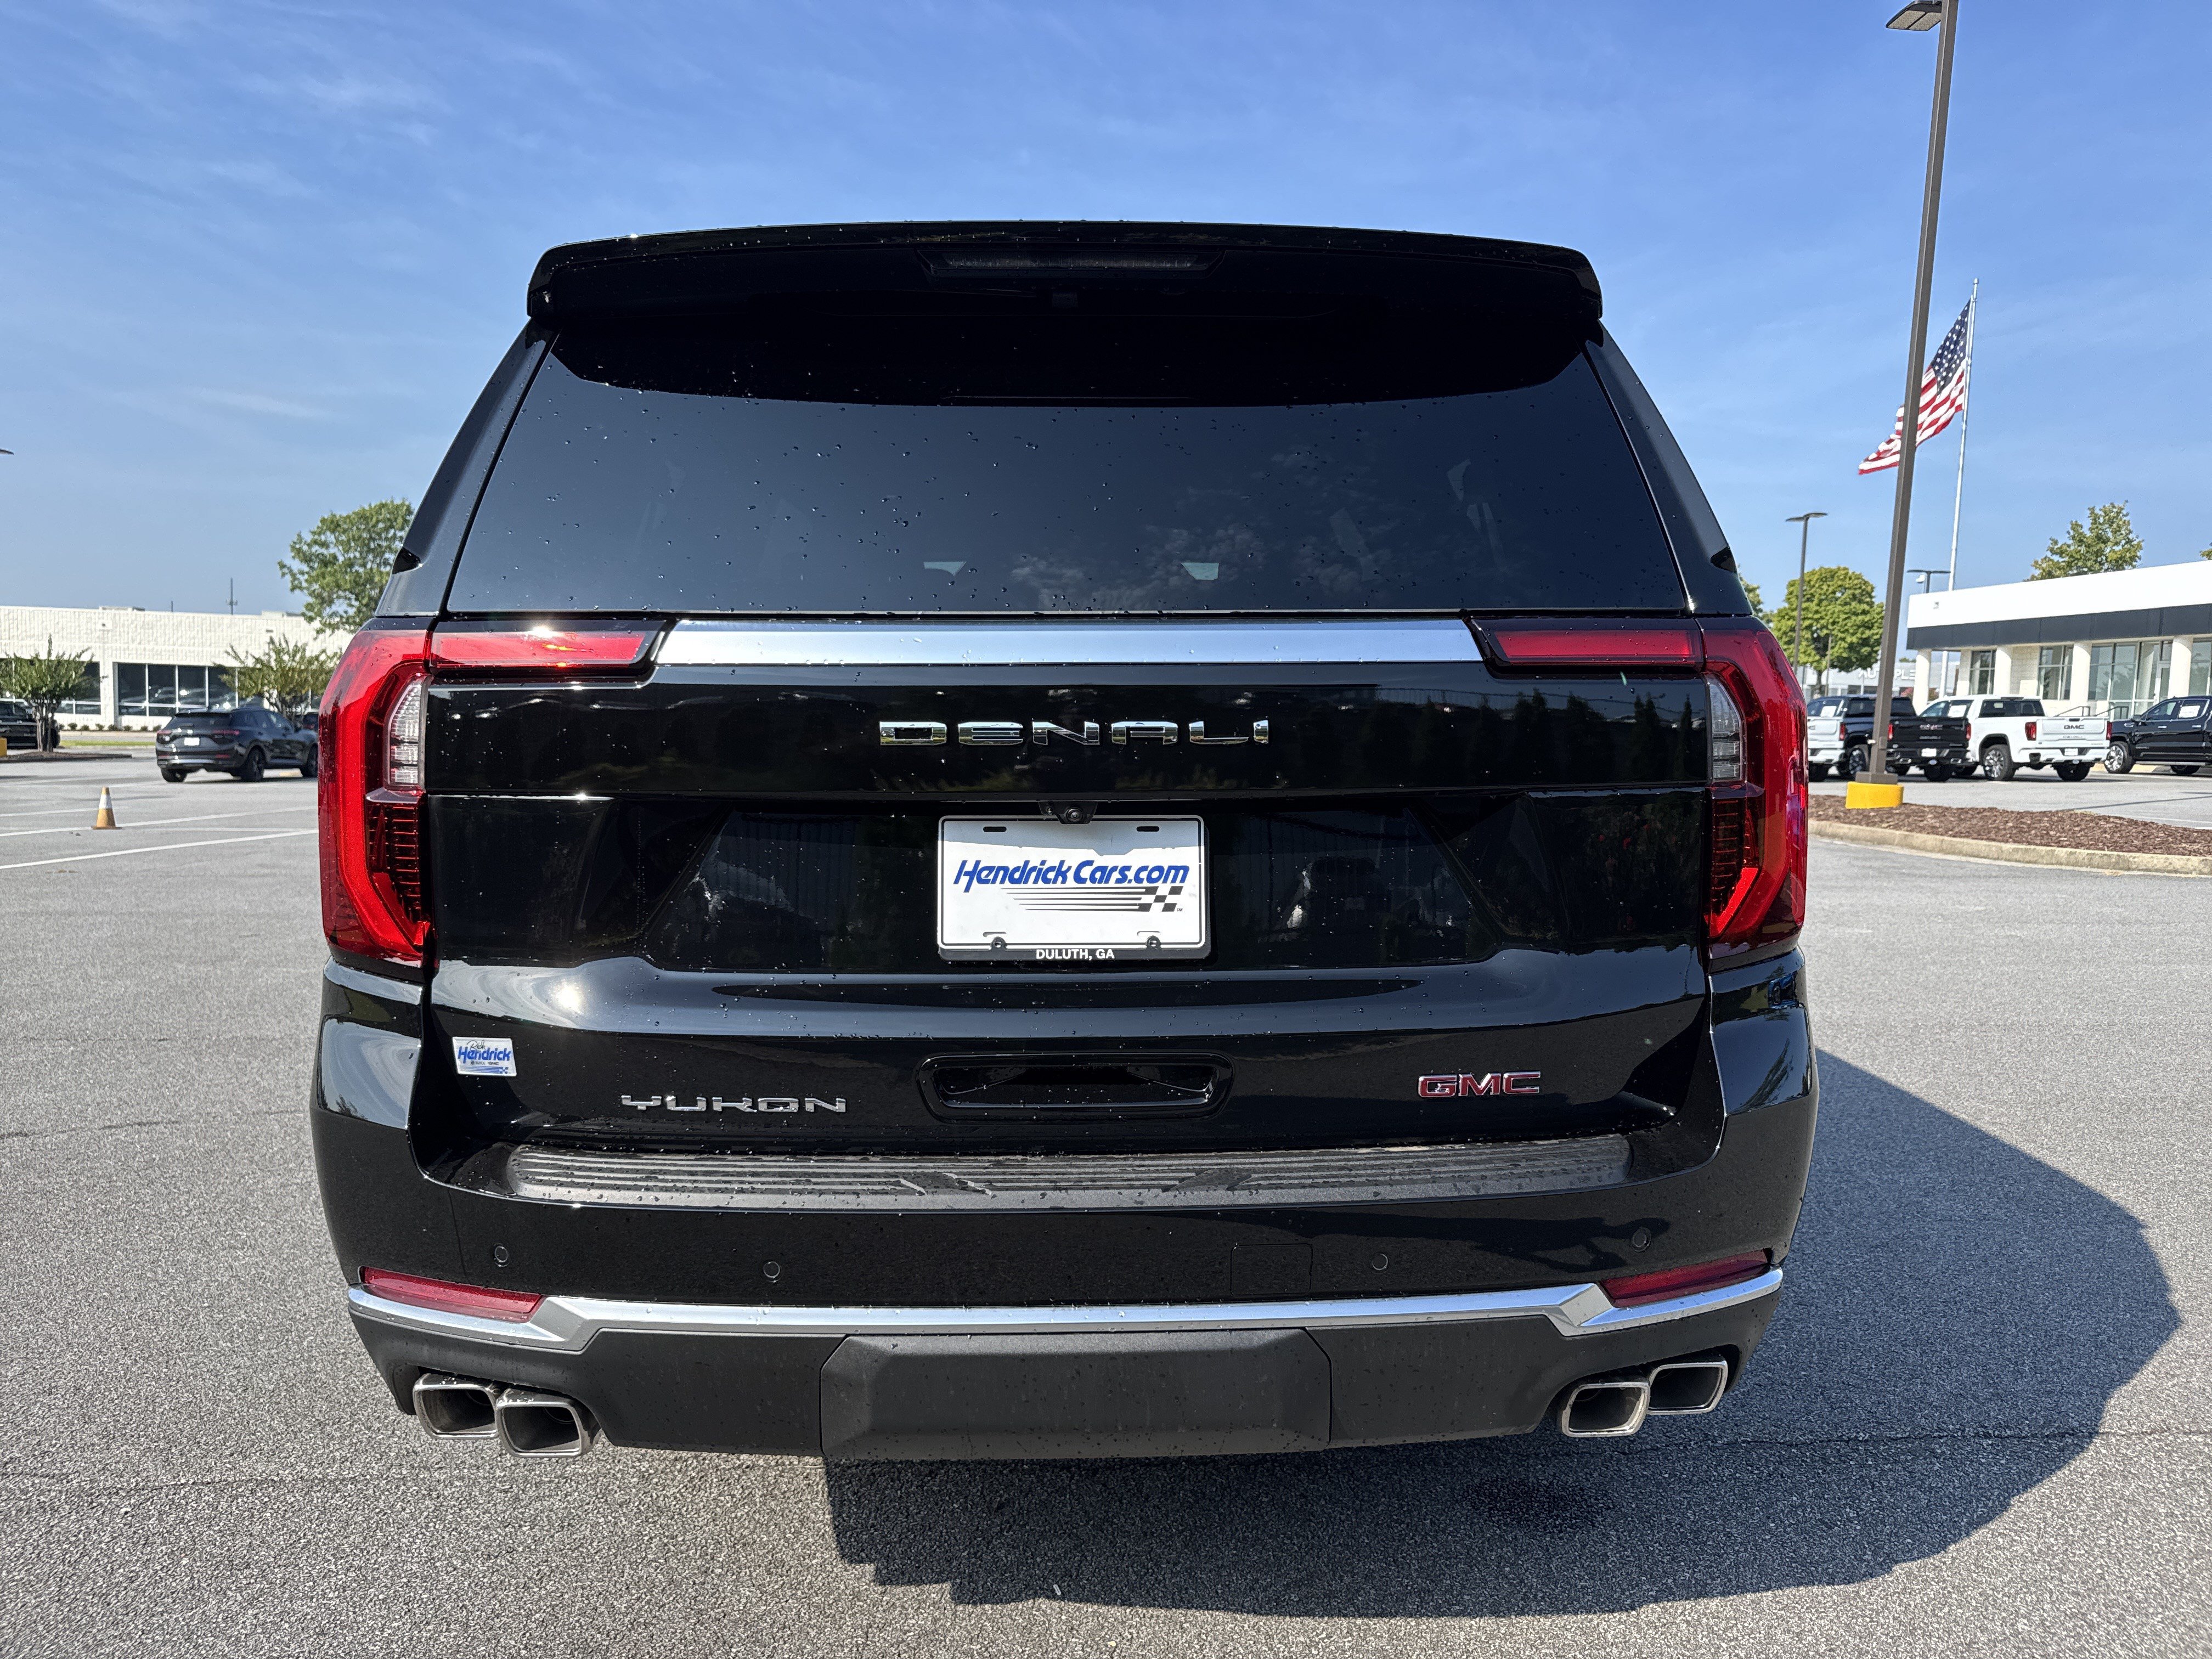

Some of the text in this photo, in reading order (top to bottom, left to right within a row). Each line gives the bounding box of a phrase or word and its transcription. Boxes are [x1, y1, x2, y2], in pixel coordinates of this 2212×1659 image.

[879, 720, 1269, 746] DENALI
[1036, 949, 1115, 960] DULUTH, GA
[458, 1046, 512, 1064] Hendrick
[467, 1040, 486, 1052] Rick
[1418, 1071, 1541, 1098] GMC
[621, 1095, 847, 1113] YUKON
